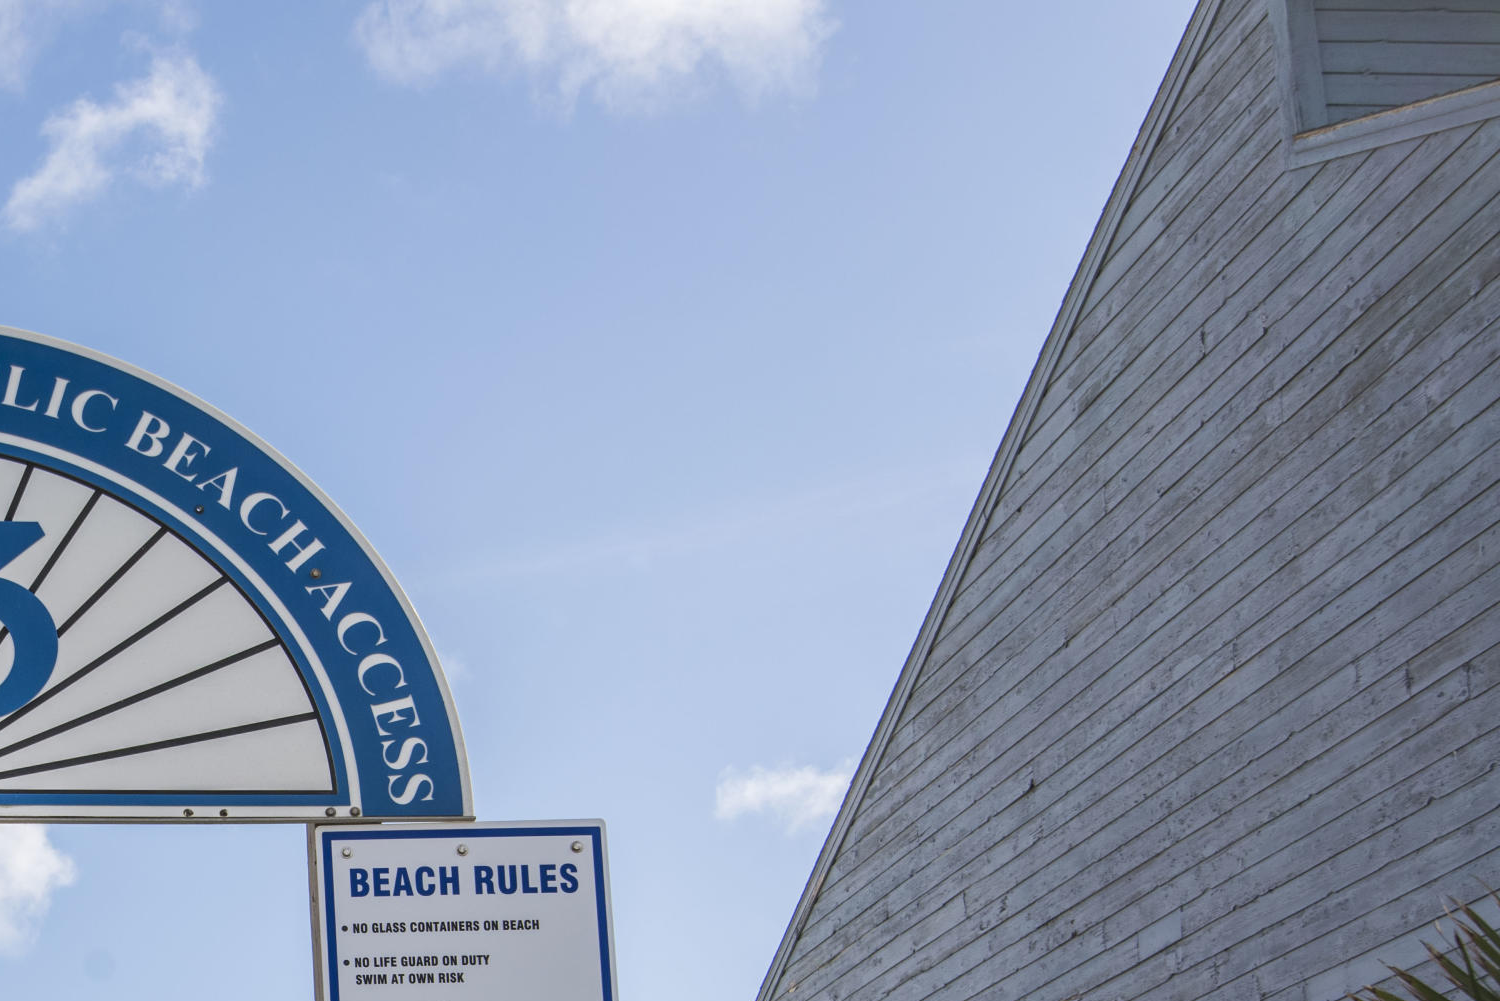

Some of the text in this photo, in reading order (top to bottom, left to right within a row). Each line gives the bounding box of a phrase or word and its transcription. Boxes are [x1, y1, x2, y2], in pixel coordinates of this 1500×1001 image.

[124, 410, 326, 575] BEACH
[304, 579, 436, 806] ACCESS
[348, 863, 579, 897] BEACH RULES
[352, 919, 539, 934] NO GLASS CONTAINERS ON BEACH
[353, 954, 491, 969] NO LIFE GUARD ON DUTY
